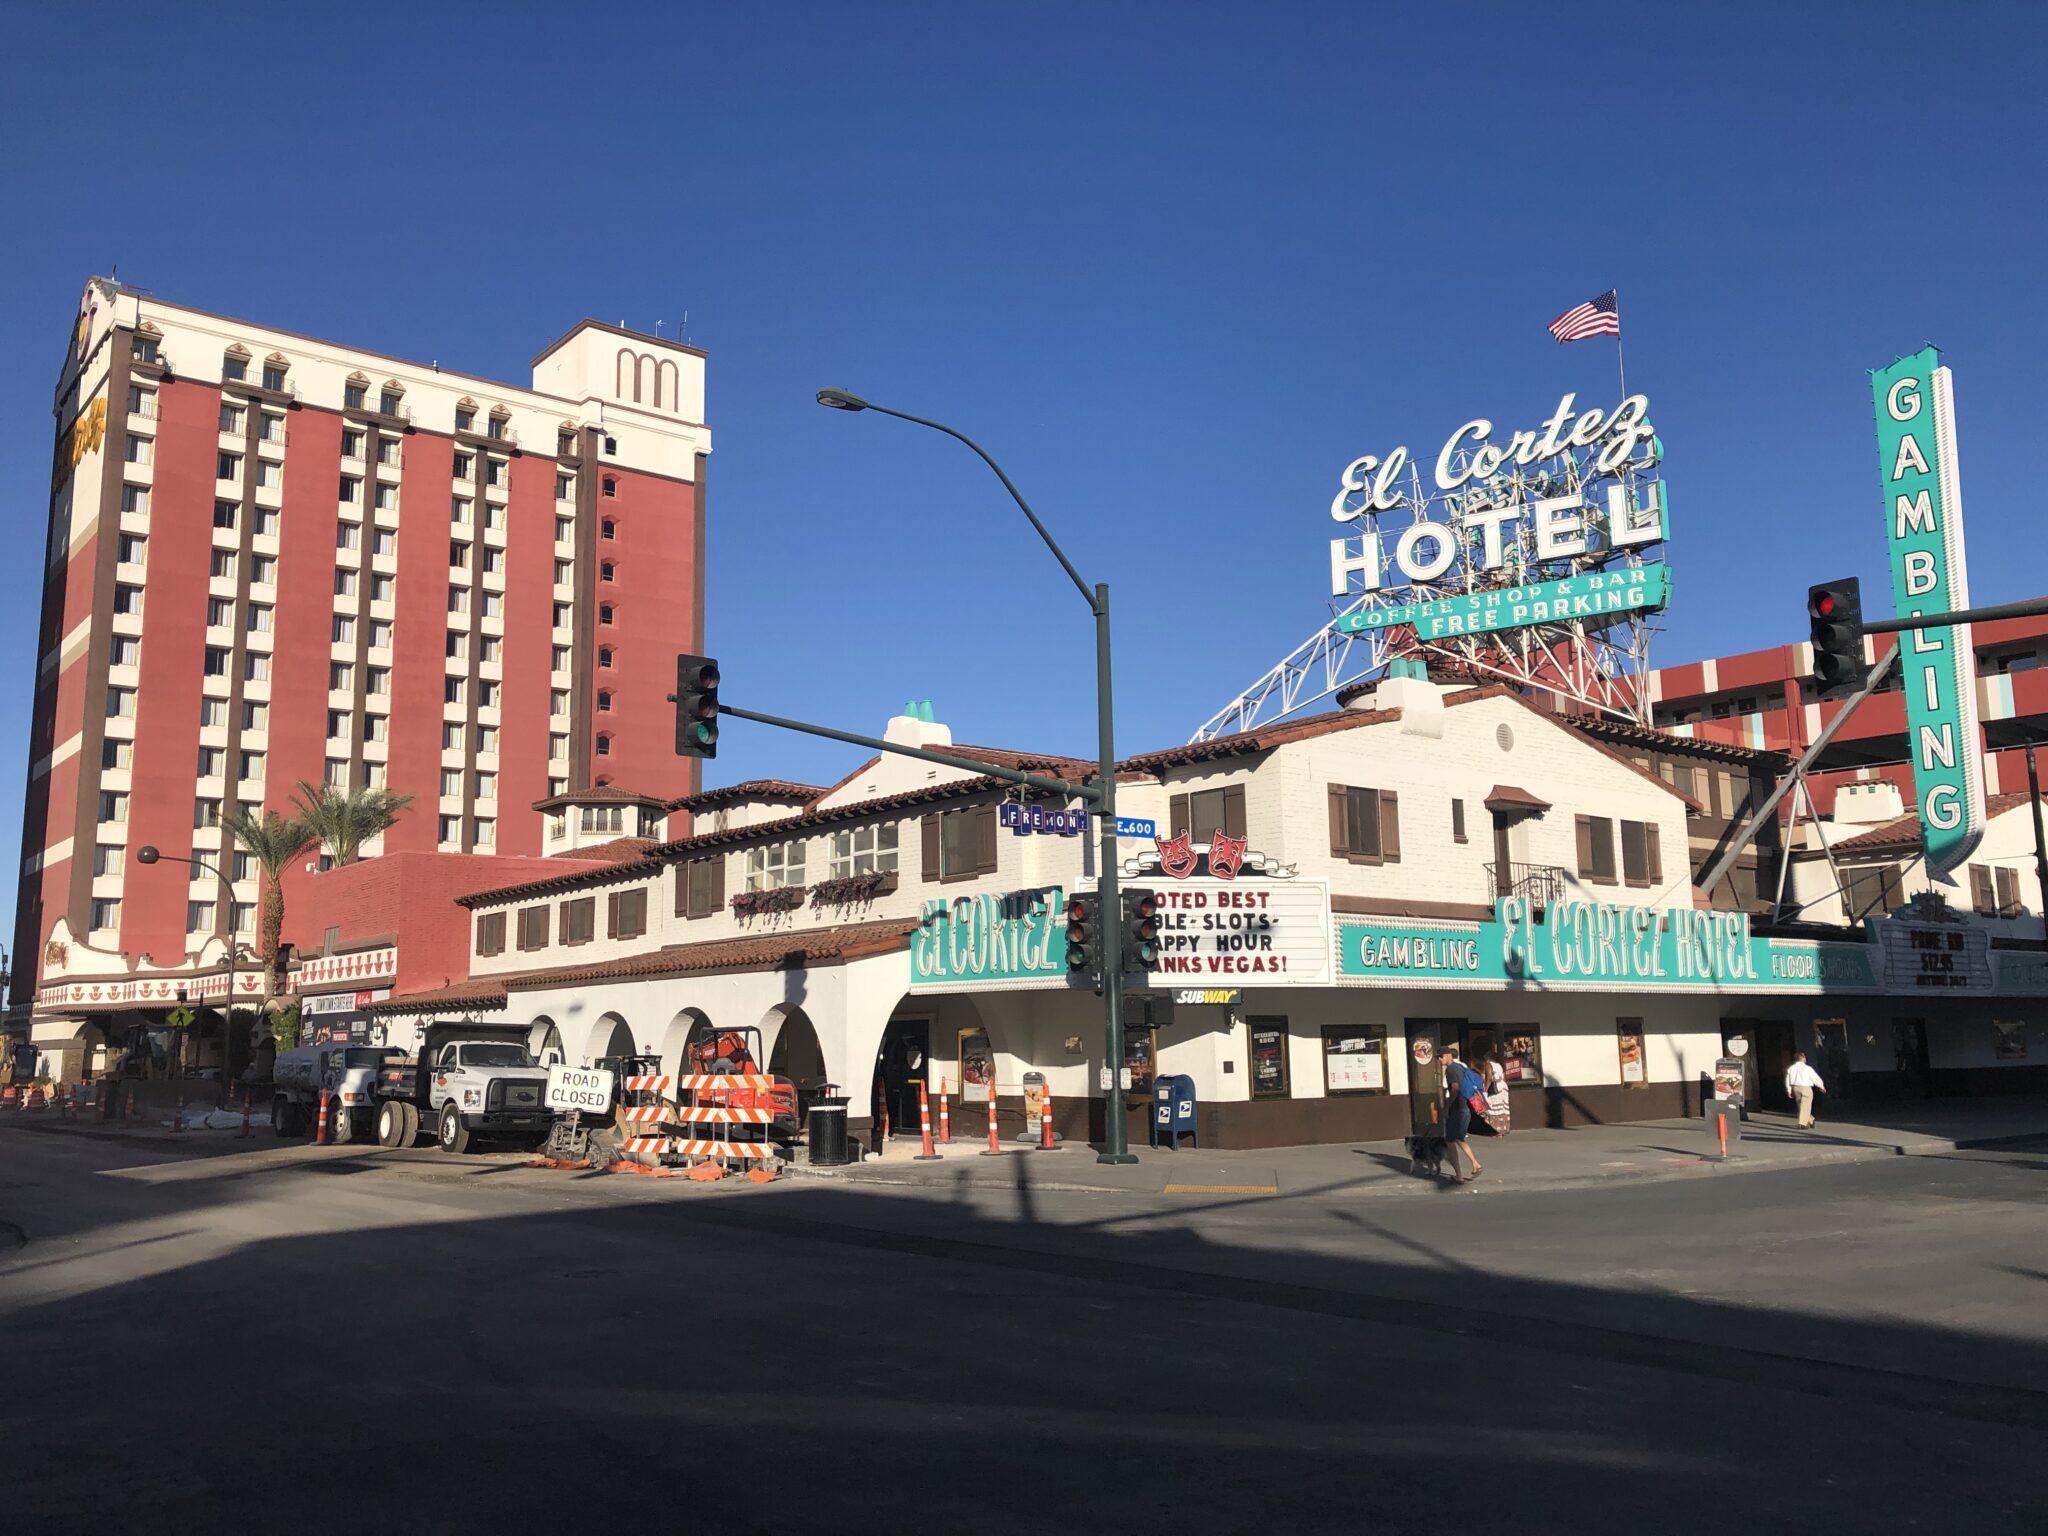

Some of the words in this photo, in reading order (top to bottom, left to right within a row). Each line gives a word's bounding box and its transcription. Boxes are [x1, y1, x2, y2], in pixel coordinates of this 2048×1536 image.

[1331, 446, 1409, 523] El
[1435, 392, 1655, 490] Cortez
[1331, 484, 1663, 596] HOTEL
[1350, 600, 1454, 628] COFFEE
[1469, 587, 1542, 609] SHOP
[1557, 581, 1572, 595] &
[1589, 569, 1647, 590] BAR
[1431, 610, 1498, 636] FREE
[1512, 586, 1644, 624] PARKING
[1886, 377, 1962, 831] GAMBLING
[1128, 824, 1151, 834] 600
[1154, 892, 1207, 909] OTED
[1218, 891, 1270, 909] BEST
[916, 898, 947, 977] EL
[950, 889, 1058, 976] CORTEZ
[1154, 935, 1200, 952] APPY
[1216, 934, 1273, 952] HOUR
[1503, 895, 1544, 974] EL
[1551, 900, 1667, 977] CORTEZ
[1675, 909, 1759, 979] HOTEL
[1153, 956, 1203, 973] ANKS
[1207, 956, 1287, 974] VEGAS!
[1360, 933, 1480, 971] GAMBLING
[1771, 954, 1815, 979] FLOOR
[1176, 989, 1238, 1004] SUBWAY
[562, 1072, 600, 1089] ROAD
[551, 1088, 605, 1106] CLOSED
